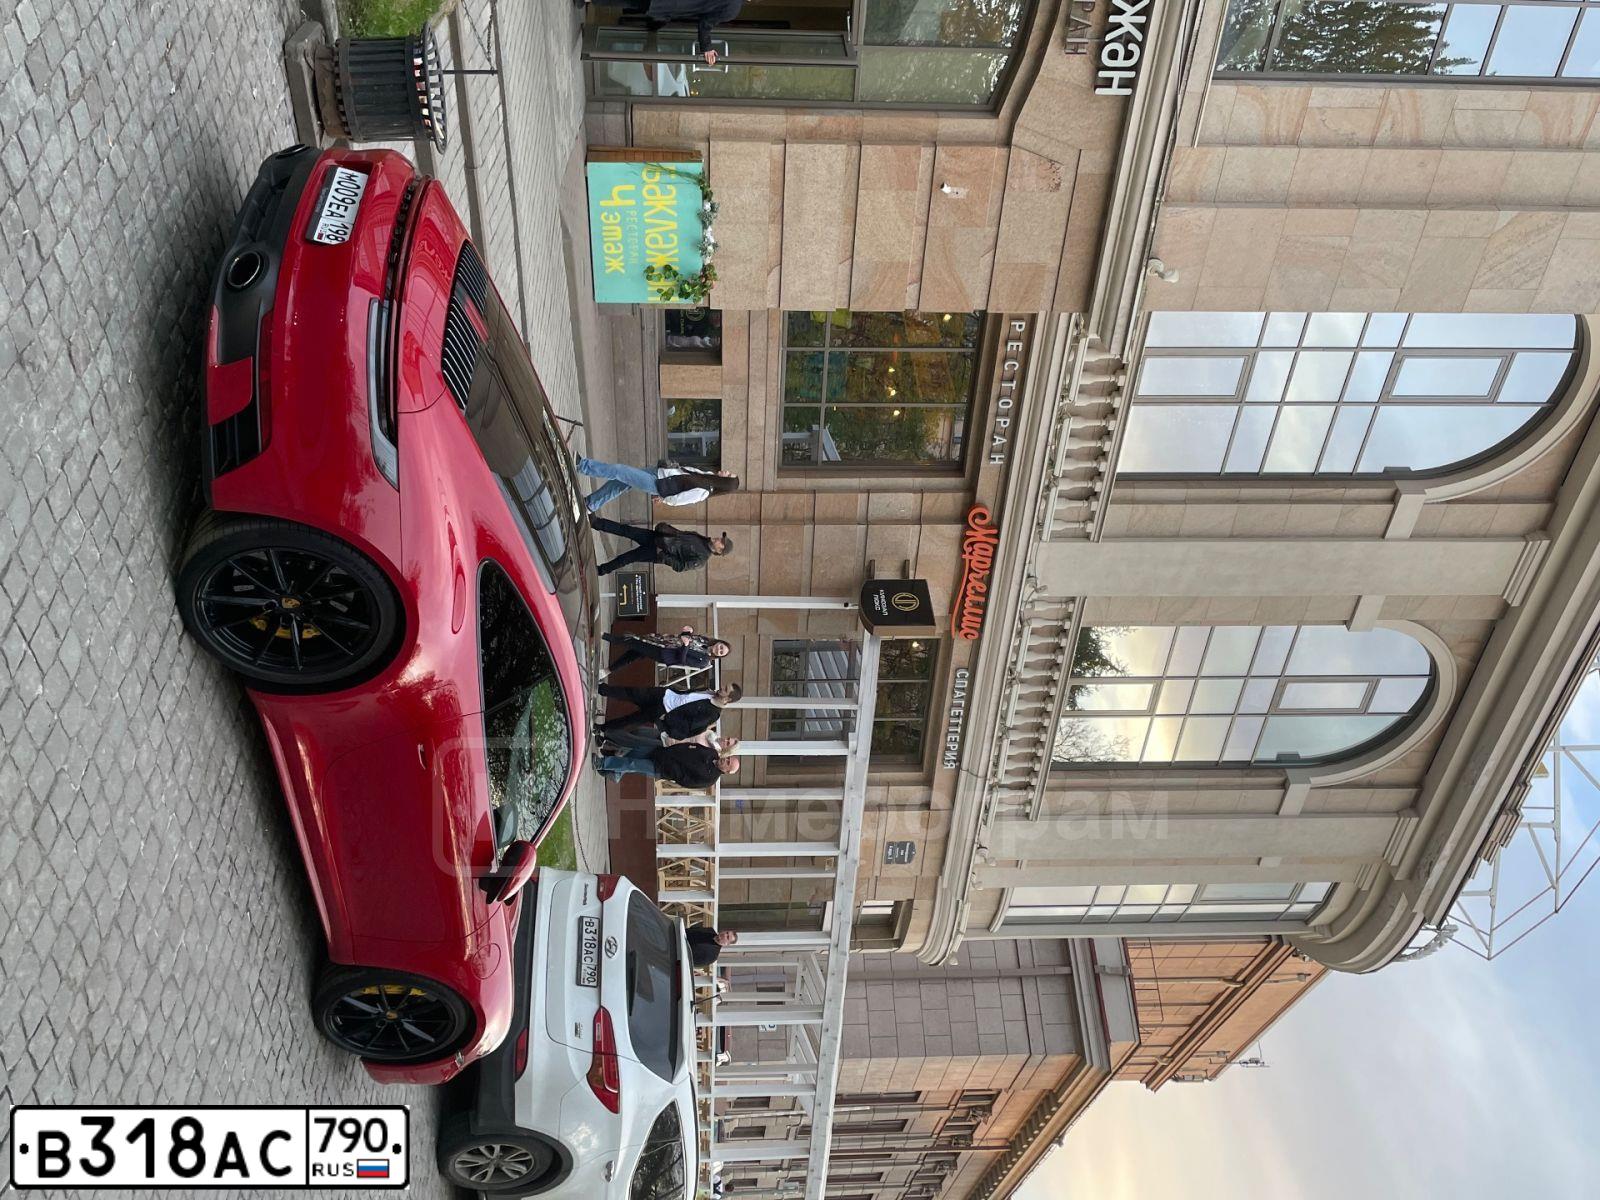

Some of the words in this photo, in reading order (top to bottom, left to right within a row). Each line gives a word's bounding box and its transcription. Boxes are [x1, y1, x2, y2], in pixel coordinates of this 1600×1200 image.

[325, 171, 361, 219] М009ЕА
[326, 222, 349, 242] 198
[600, 212, 625, 274] этаж
[989, 320, 1026, 465] РЕСТОРАН
[942, 668, 970, 770] СПАГЕТТЕРИЯ
[586, 965, 597, 983] 790
